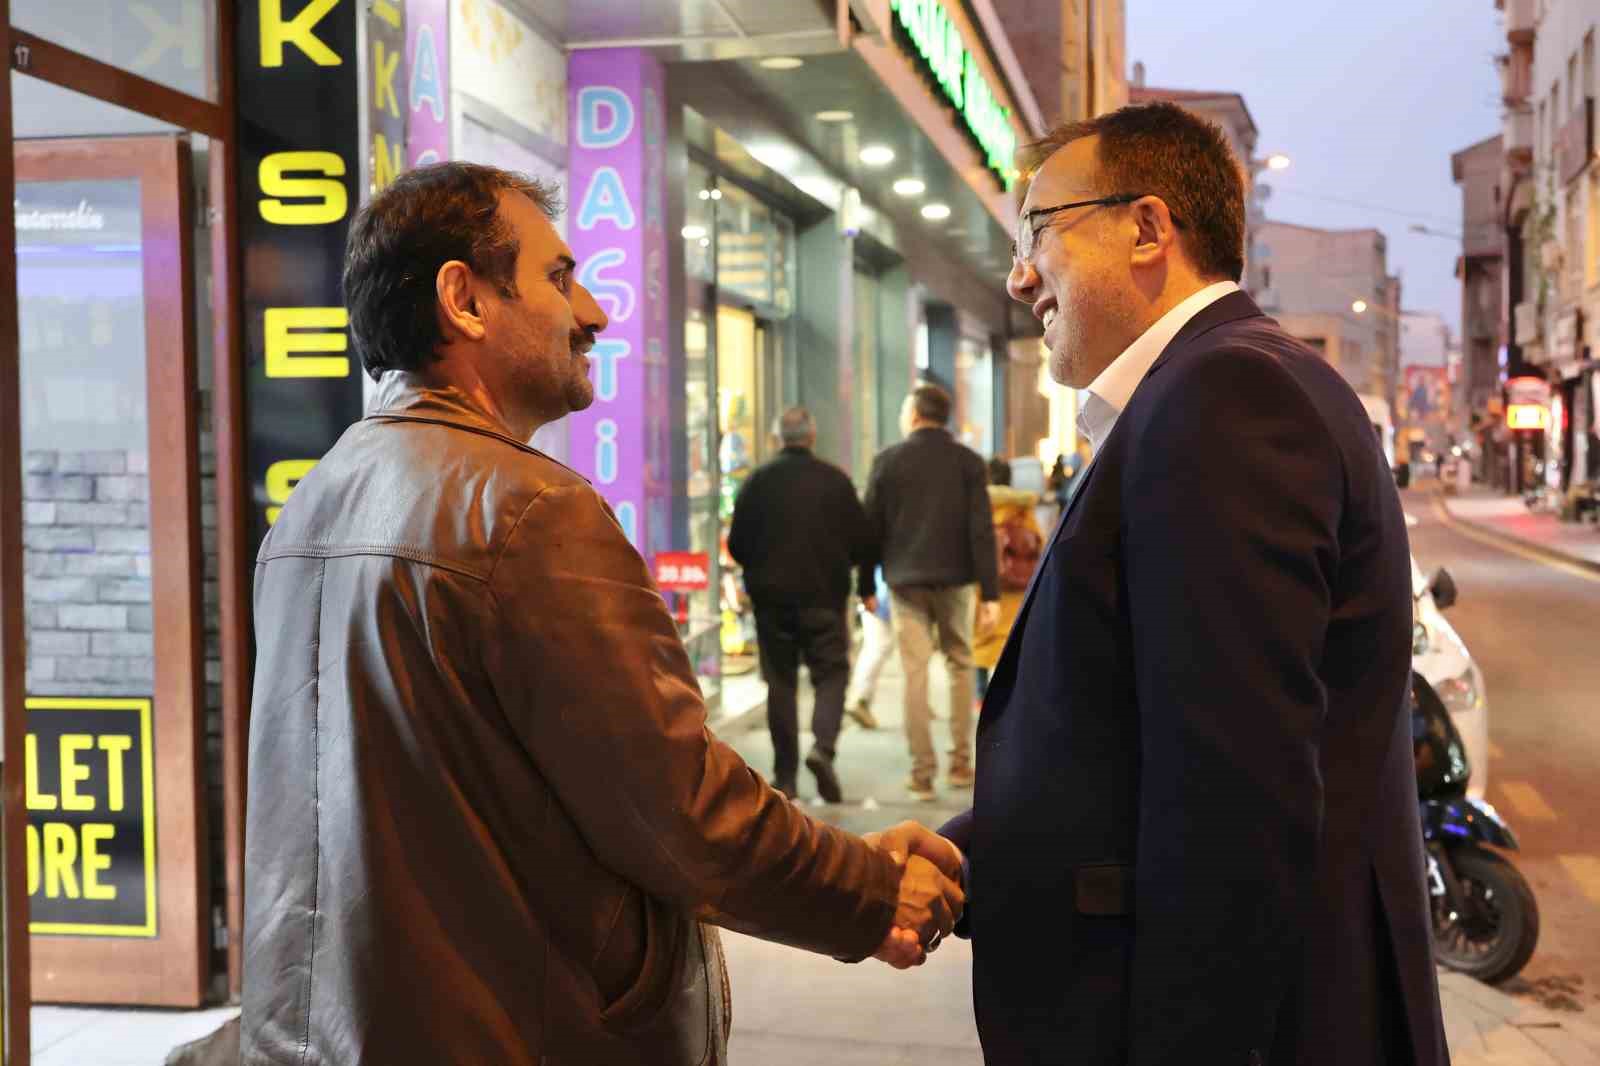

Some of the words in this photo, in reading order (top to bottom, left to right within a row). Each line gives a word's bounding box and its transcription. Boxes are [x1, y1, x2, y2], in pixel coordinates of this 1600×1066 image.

[14, 44, 31, 67] 17
[409, 24, 445, 167] A
[25, 734, 132, 811] LET
